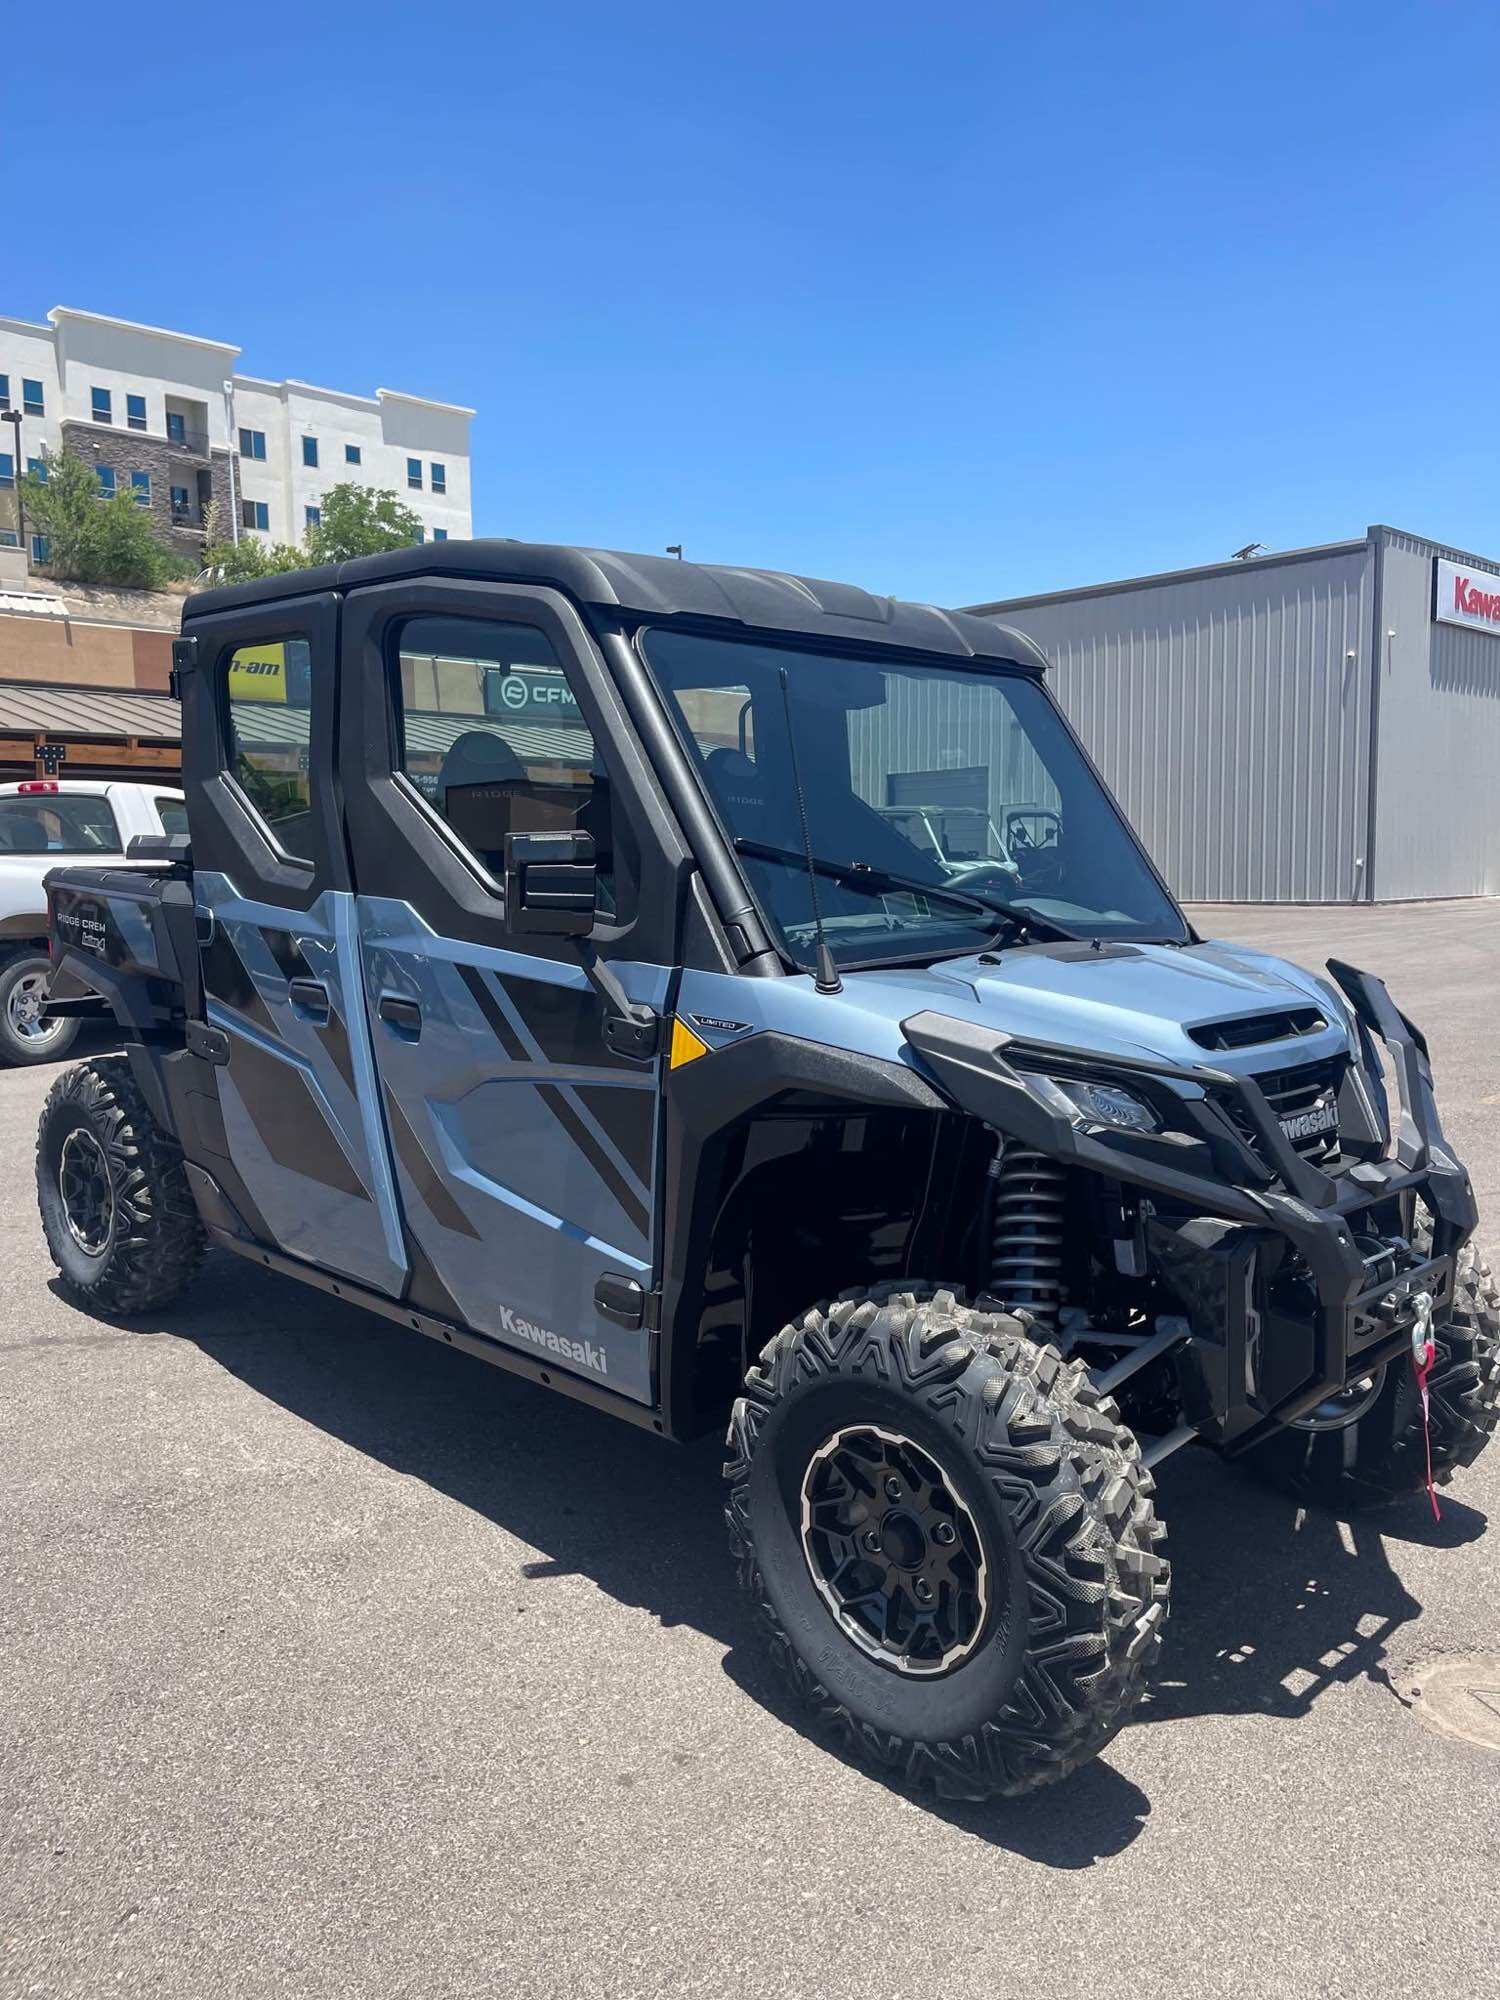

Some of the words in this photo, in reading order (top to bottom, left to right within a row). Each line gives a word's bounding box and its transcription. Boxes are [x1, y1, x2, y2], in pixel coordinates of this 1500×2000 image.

[1454, 575, 1500, 621] Kawa
[230, 660, 280, 676] n-am
[532, 686, 577, 705] CFM
[57, 912, 80, 927] RIDGE
[82, 919, 106, 932] CREW
[700, 1017, 736, 1029] LIMITED
[1278, 1099, 1340, 1140] awasaki
[499, 1304, 608, 1374] Kawasaki
